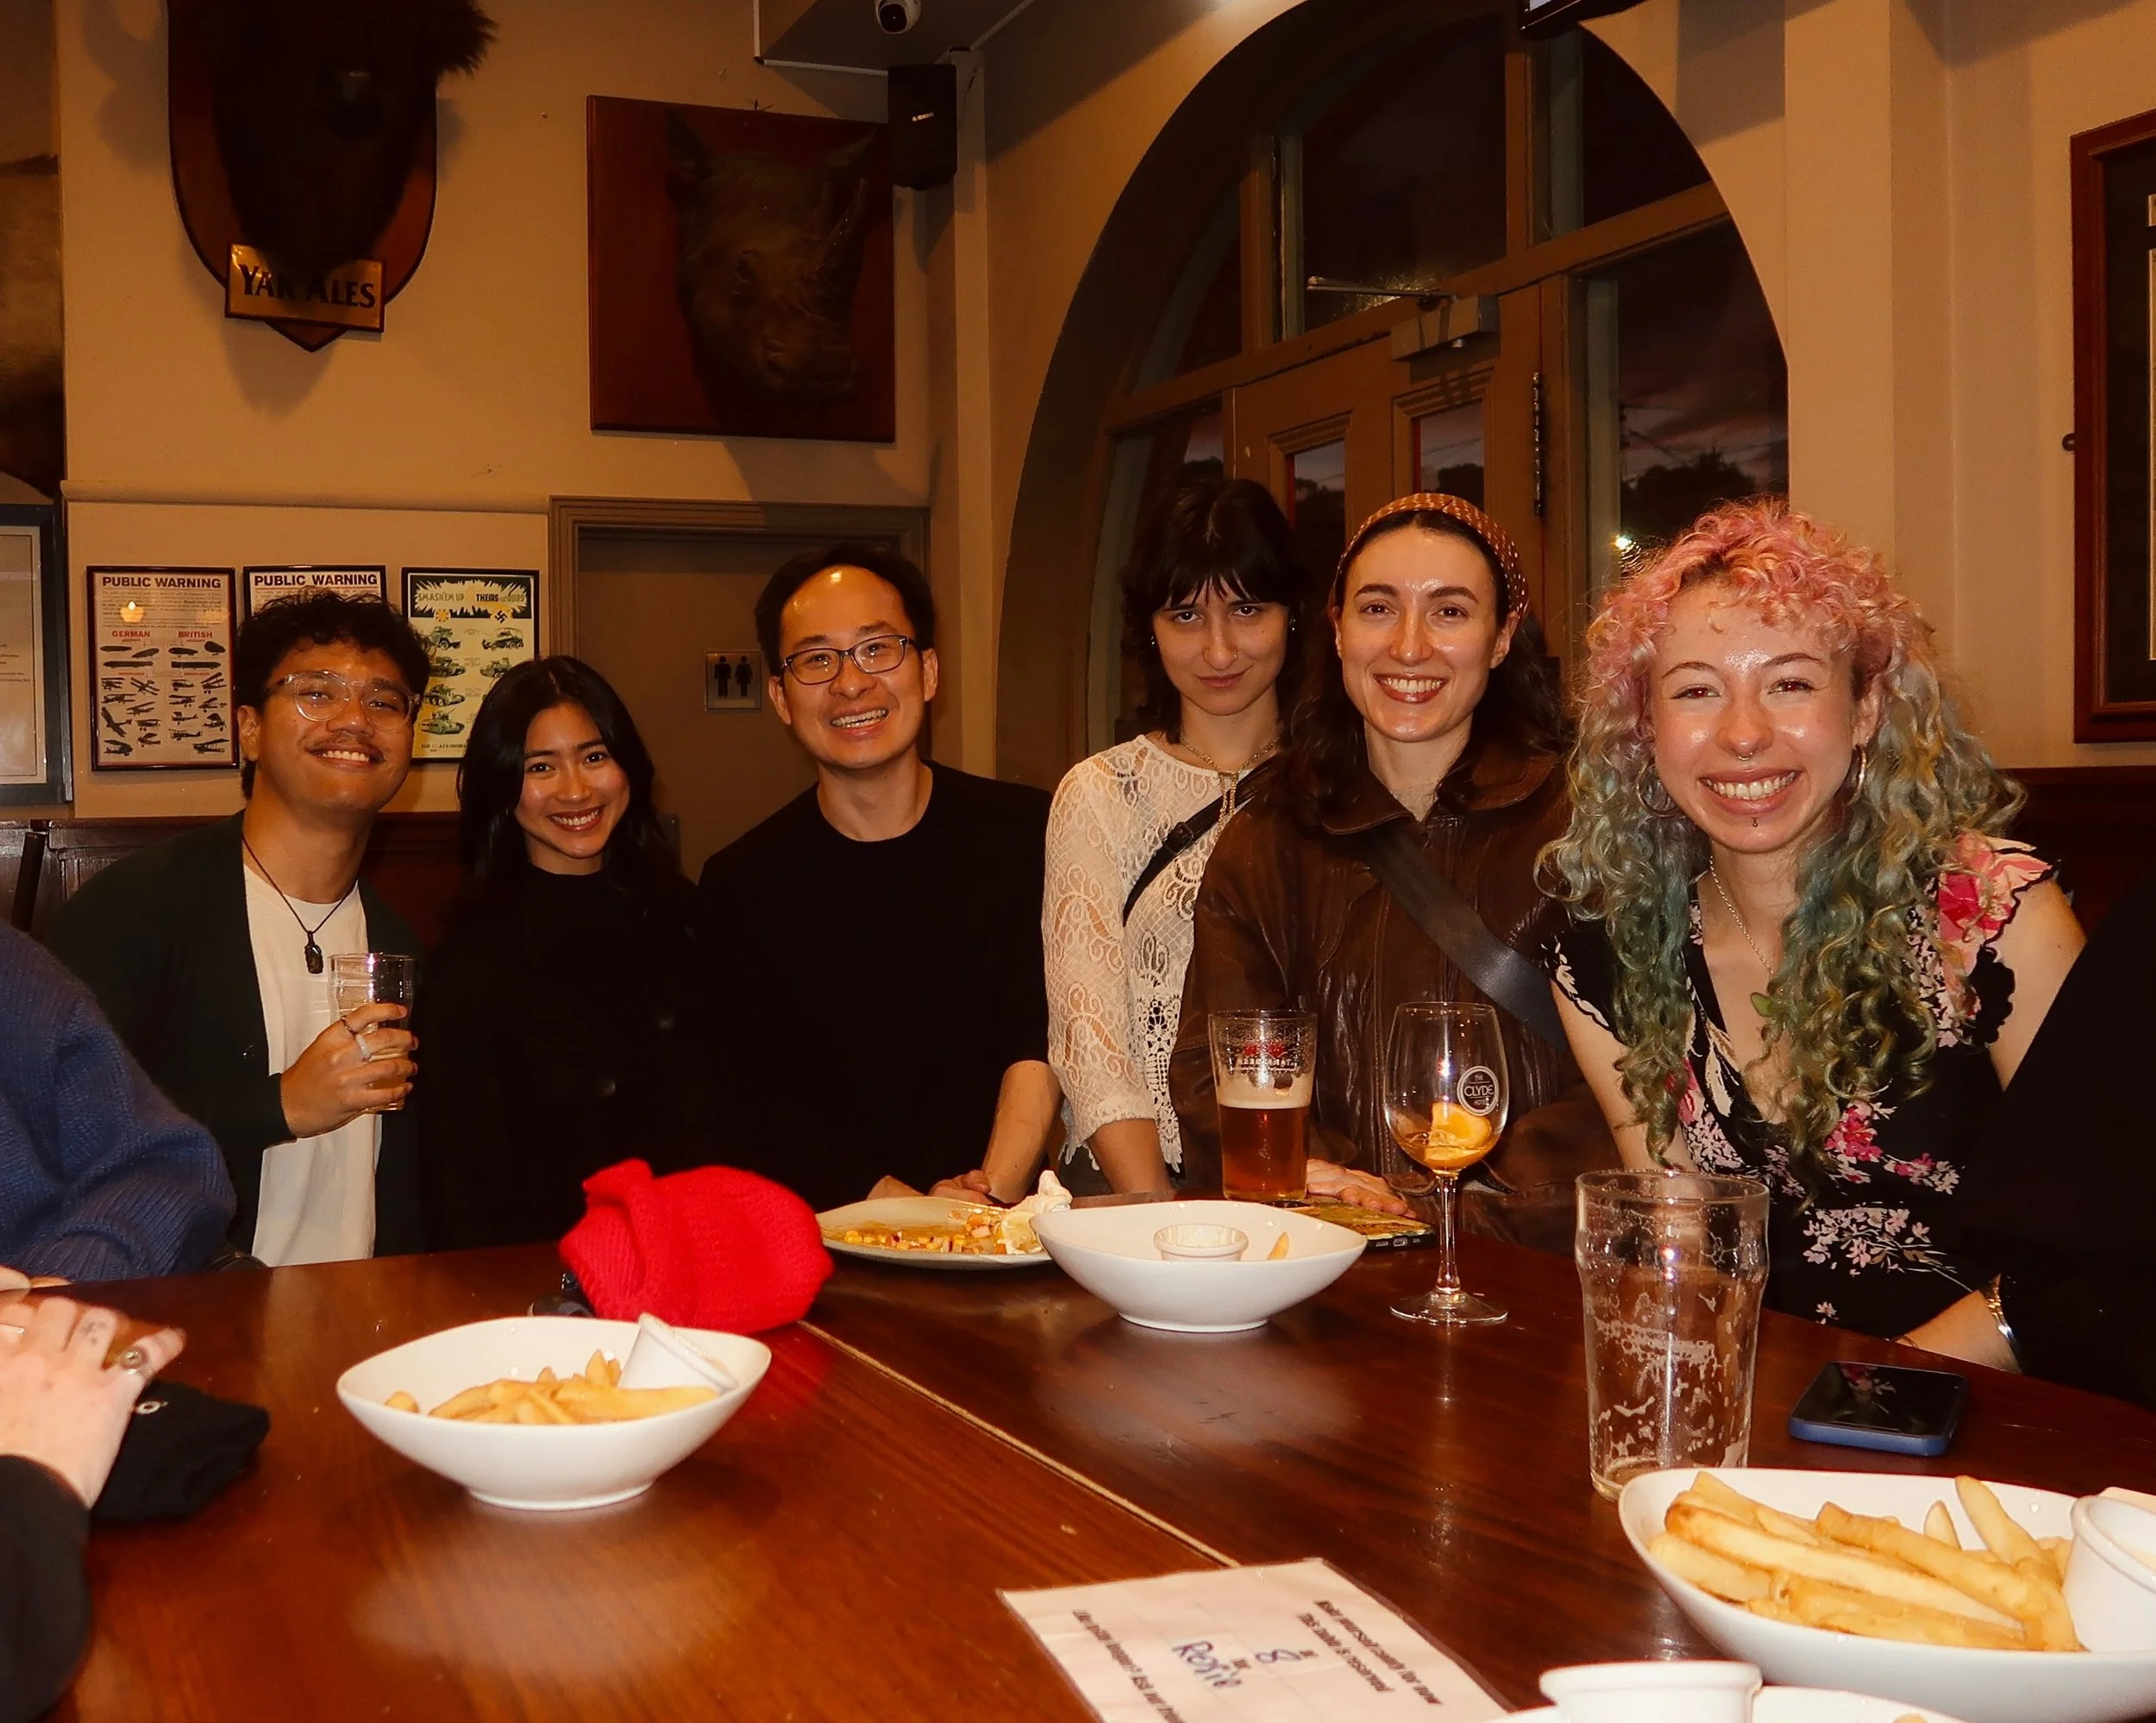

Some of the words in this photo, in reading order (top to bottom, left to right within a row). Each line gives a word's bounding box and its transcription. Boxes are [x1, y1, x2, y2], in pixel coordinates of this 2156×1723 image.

[239, 263, 295, 300] YAK
[306, 273, 377, 309] ALES
[102, 576, 152, 588] PUBLIC
[155, 577, 222, 589] WARNING
[254, 574, 306, 586] PUBLIC
[311, 573, 378, 586] WARNING
[475, 593, 499, 603] THEIRS
[1463, 1084, 1495, 1097] CLYDE
